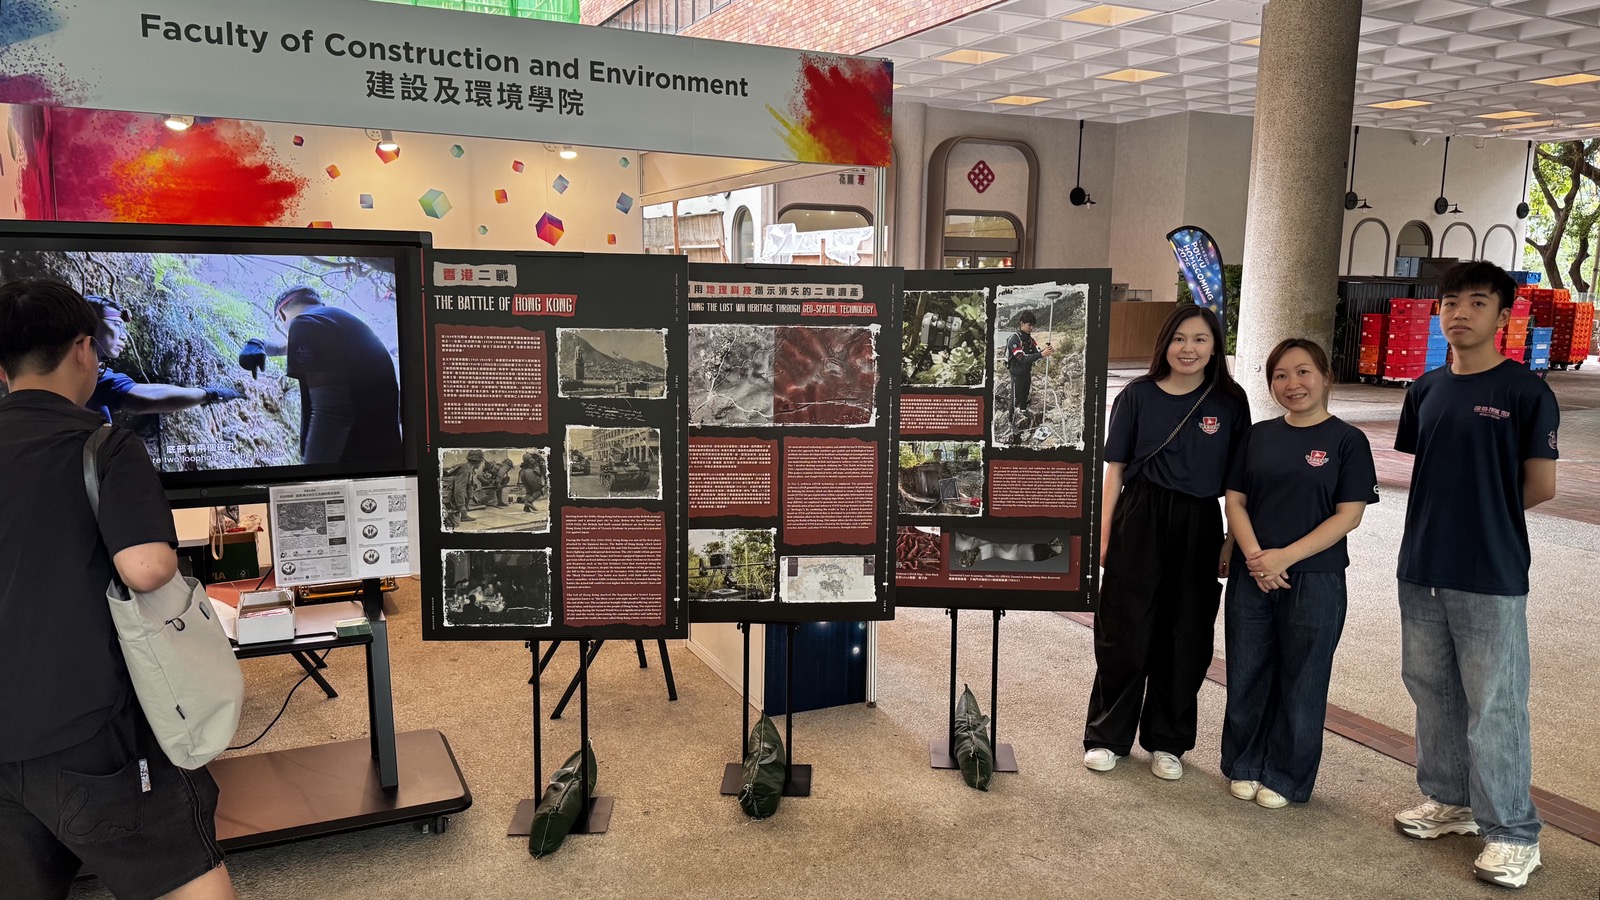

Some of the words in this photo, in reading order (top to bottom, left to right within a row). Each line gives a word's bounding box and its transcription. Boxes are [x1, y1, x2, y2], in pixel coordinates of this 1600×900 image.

[140, 13, 268, 53] Faculty
[280, 29, 313, 53] of
[324, 32, 520, 74] Construction
[529, 57, 580, 80] and
[589, 60, 749, 97] Environment
[365, 70, 585, 117] 建設及環境學院
[1191, 242, 1206, 268] POLYU
[442, 268, 509, 283] 香港二戰
[1184, 244, 1213, 300] HOMECOMING
[434, 295, 453, 310] THE
[457, 295, 495, 311] BATTLE
[498, 296, 511, 312] OF
[515, 297, 542, 312] HONG
[546, 297, 573, 313] KONG
[707, 302, 718, 312] THE
[719, 303, 734, 312] LOST
[747, 303, 774, 313] HERITAGE
[775, 303, 801, 313] THROUGH
[802, 304, 837, 314] GEO-SPATIAL
[840, 304, 874, 314] TECHNOLOGY
[182, 454, 222, 463] loopholes
[253, 450, 283, 459] bottom
